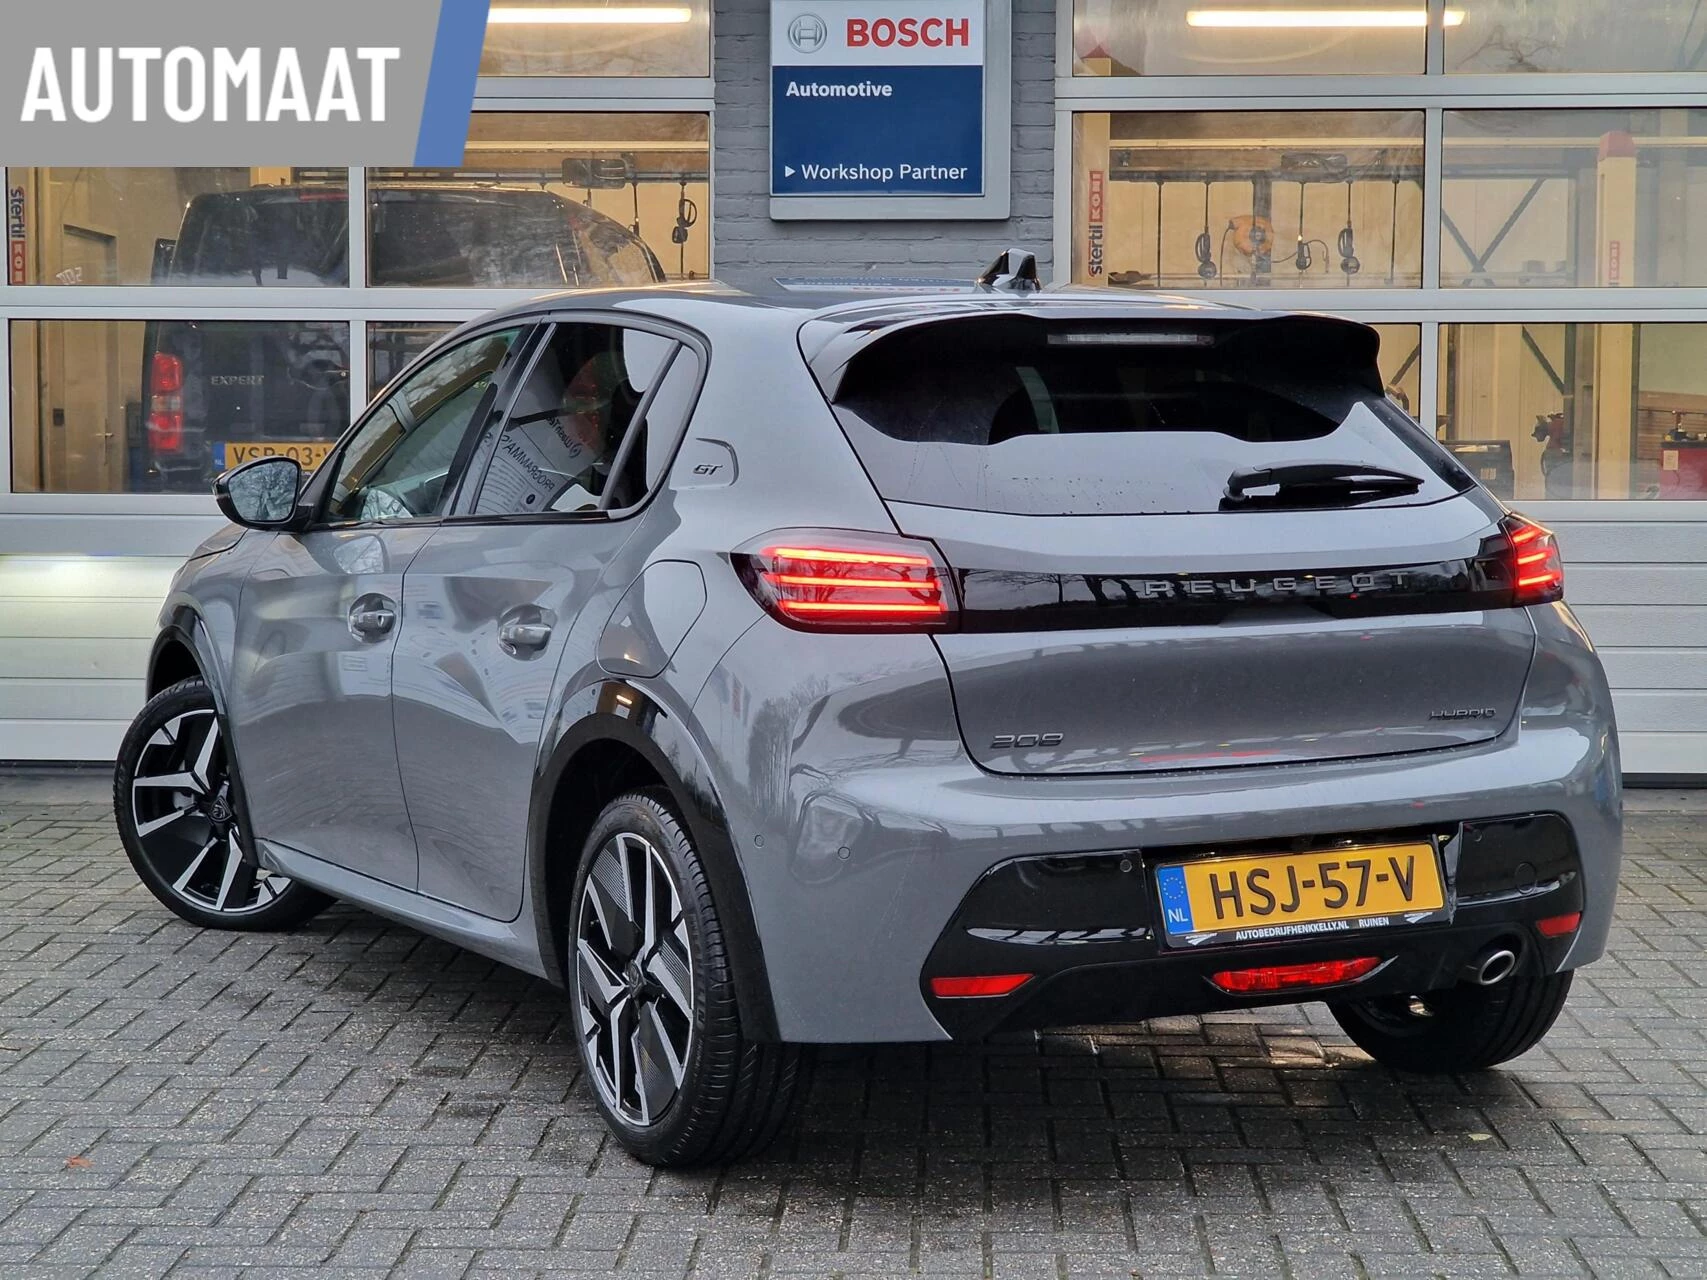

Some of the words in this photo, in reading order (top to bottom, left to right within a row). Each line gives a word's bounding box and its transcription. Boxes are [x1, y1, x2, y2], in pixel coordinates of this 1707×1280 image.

[846, 17, 969, 48] BOSCH
[786, 81, 893, 97] Automotive
[801, 164, 893, 182] Workshop
[899, 164, 968, 180] Partner
[10, 186, 26, 239] stertil
[1088, 225, 1103, 277] stertil
[13, 242, 25, 284] KON
[211, 375, 264, 386] EXPERT
[693, 464, 723, 475] GT
[1145, 572, 1408, 595] PEUGEOT
[991, 732, 1063, 749] 208
[1209, 855, 1415, 919] HSJ-57-V
[1168, 907, 1189, 923] NL
[1358, 916, 1390, 928] RUINEN
